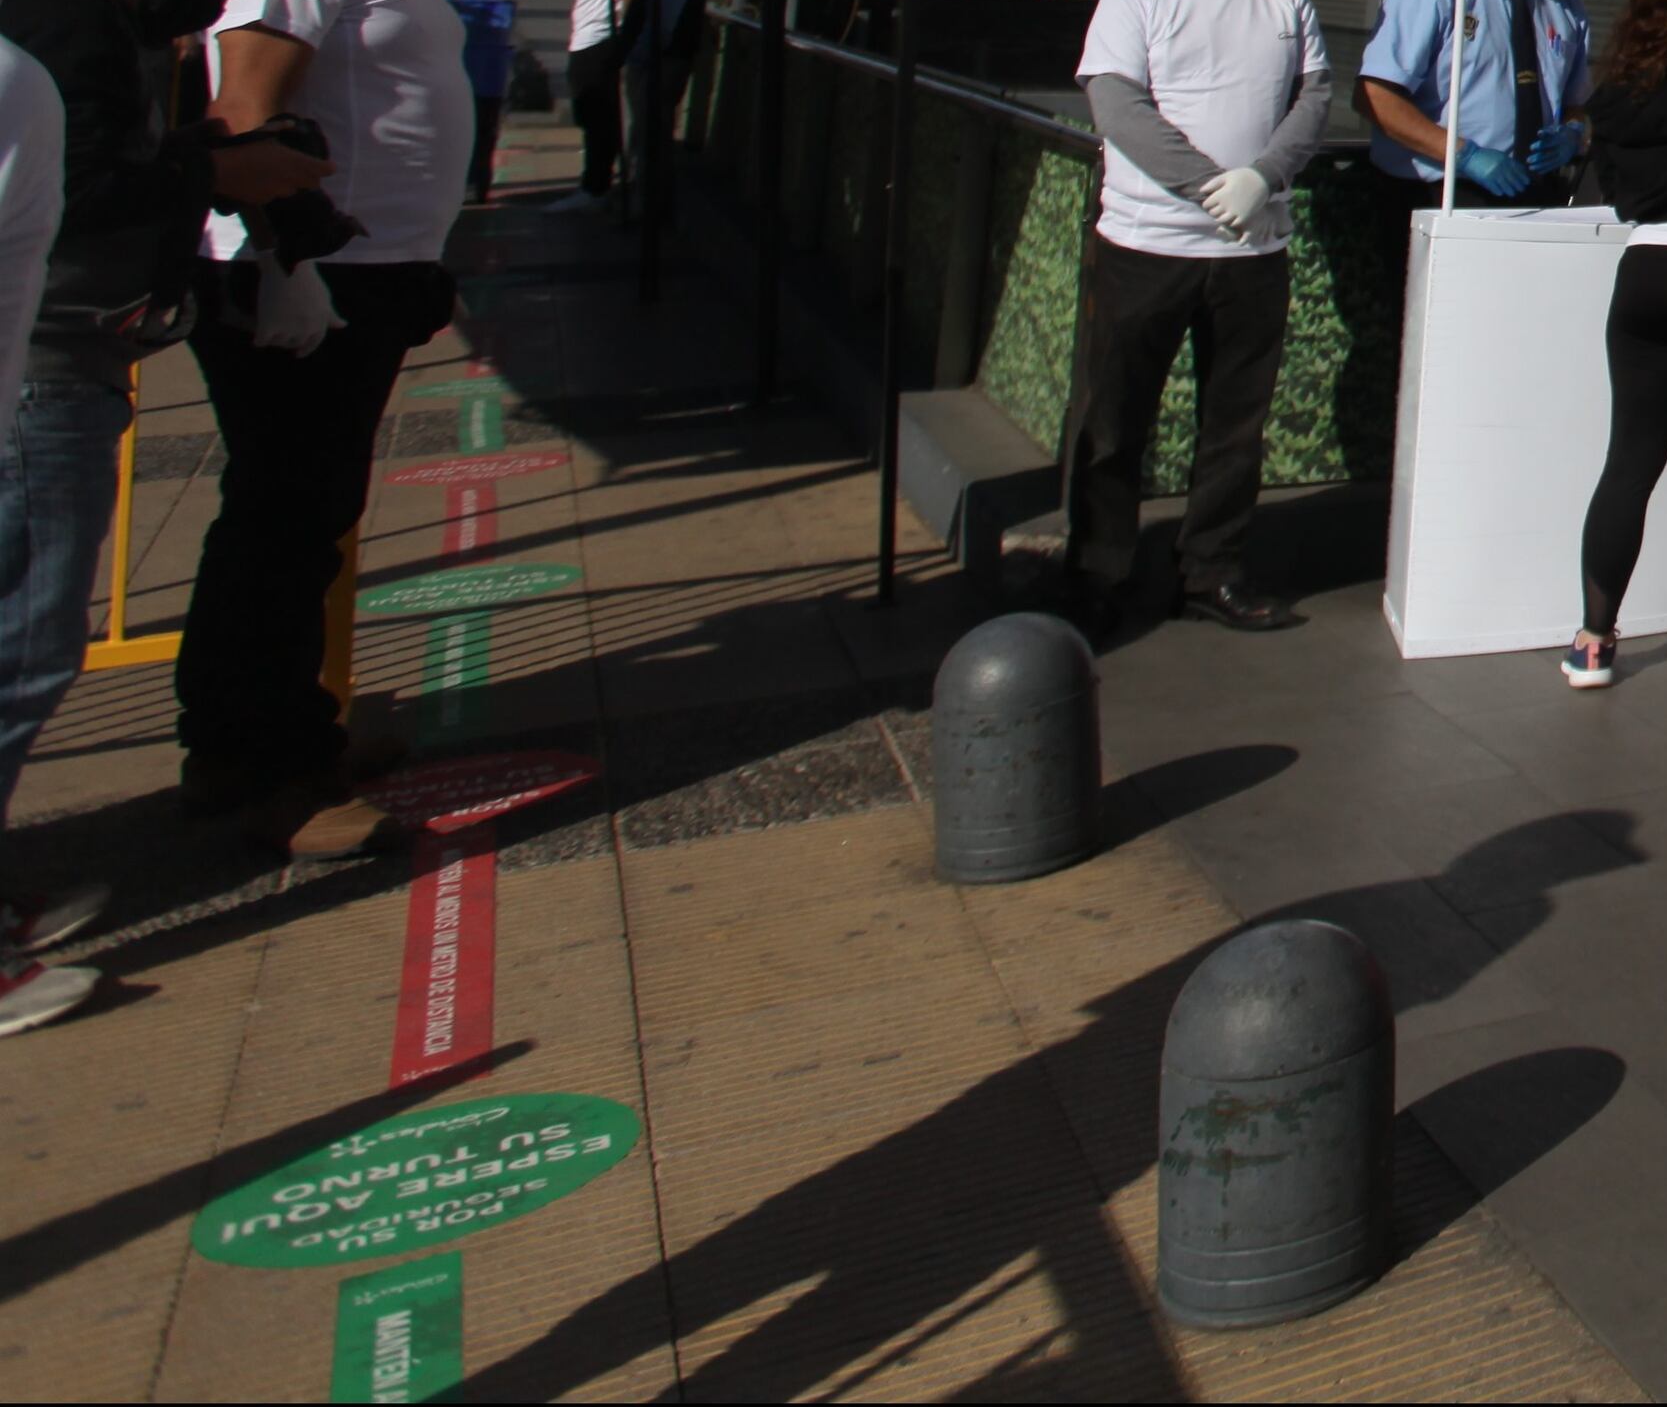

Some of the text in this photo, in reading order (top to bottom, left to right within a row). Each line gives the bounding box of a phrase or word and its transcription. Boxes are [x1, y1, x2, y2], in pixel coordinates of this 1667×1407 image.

[434, 895, 462, 929] MENOS
[437, 883, 462, 896] AL
[430, 944, 458, 979] METRO
[433, 929, 459, 945] UN
[428, 978, 457, 996] DE
[424, 995, 456, 1058] DISTANCIA
[272, 1121, 572, 1203] SU TURNO
[396, 1134, 613, 1199] ESPERE
[292, 1178, 548, 1249] SEGURIDAD
[338, 1200, 504, 1252] POR SU
[372, 1310, 422, 1391] MANTÉN
